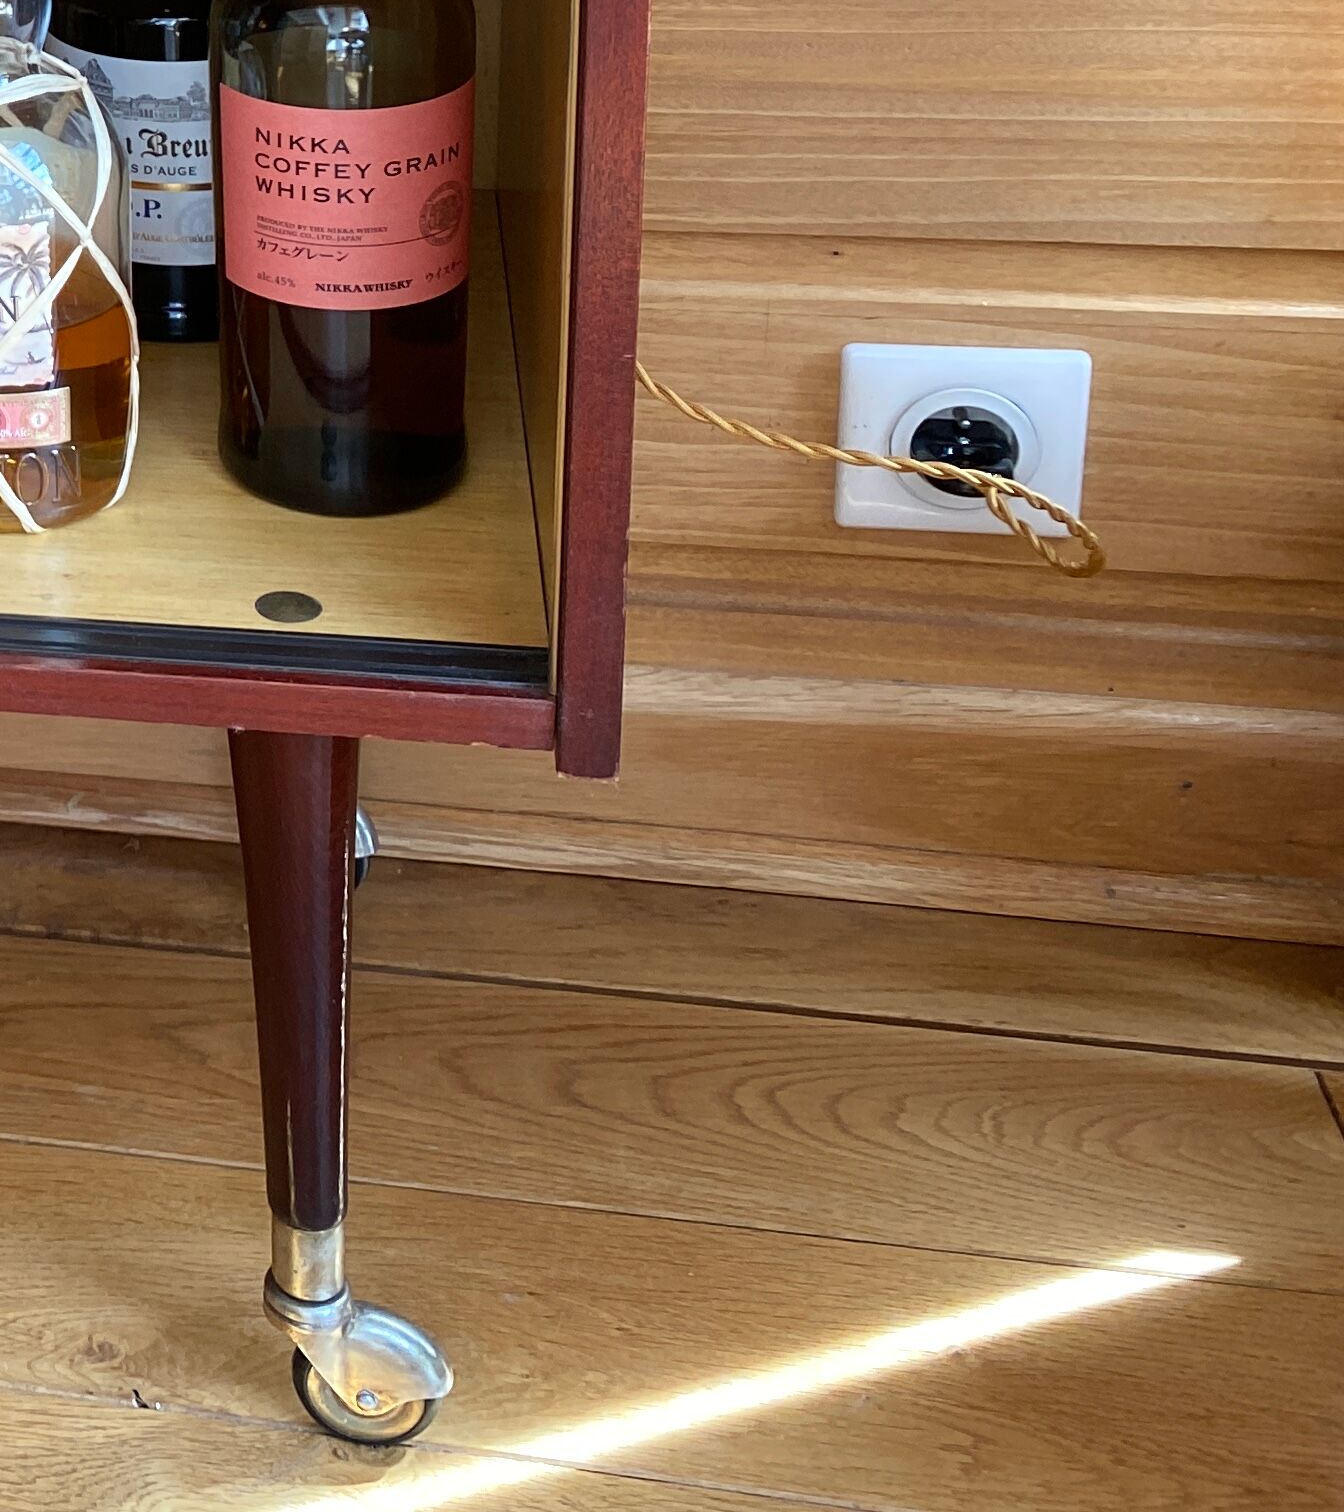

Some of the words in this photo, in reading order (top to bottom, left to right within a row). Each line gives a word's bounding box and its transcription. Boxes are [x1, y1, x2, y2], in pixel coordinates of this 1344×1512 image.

[138, 128, 211, 158] Breu
[255, 127, 350, 154] NIKKA
[143, 166, 197, 176] D'AUGE
[254, 152, 372, 179] COFFEY
[383, 142, 459, 177] GRAIN
[254, 175, 376, 204] WHISKY
[256, 237, 350, 262] カフェグレーン
